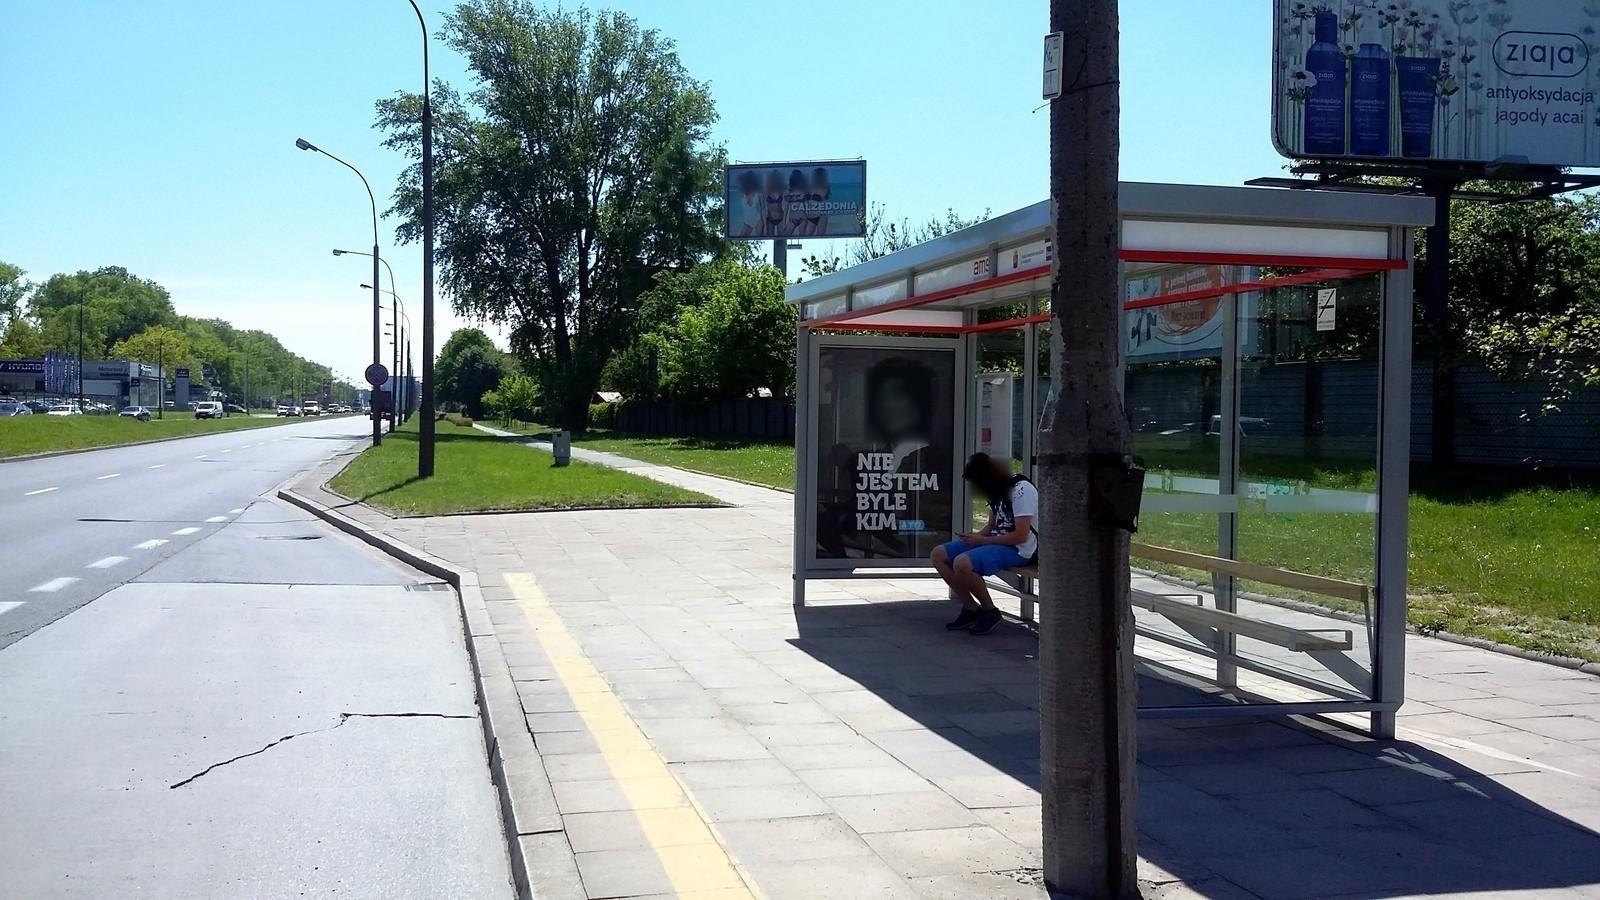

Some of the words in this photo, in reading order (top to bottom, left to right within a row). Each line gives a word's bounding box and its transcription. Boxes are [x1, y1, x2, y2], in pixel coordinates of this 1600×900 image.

[1507, 43, 1575, 71] ziaja
[1486, 86, 1594, 105] antyoksydacja
[1495, 109, 1548, 126] jagody
[1553, 109, 1584, 125] acai
[791, 201, 858, 211] CALZEDONIA
[856, 453, 895, 471] NIE
[855, 473, 939, 491] JESTEM
[856, 493, 907, 511] BYLE
[855, 513, 897, 531] KIM
